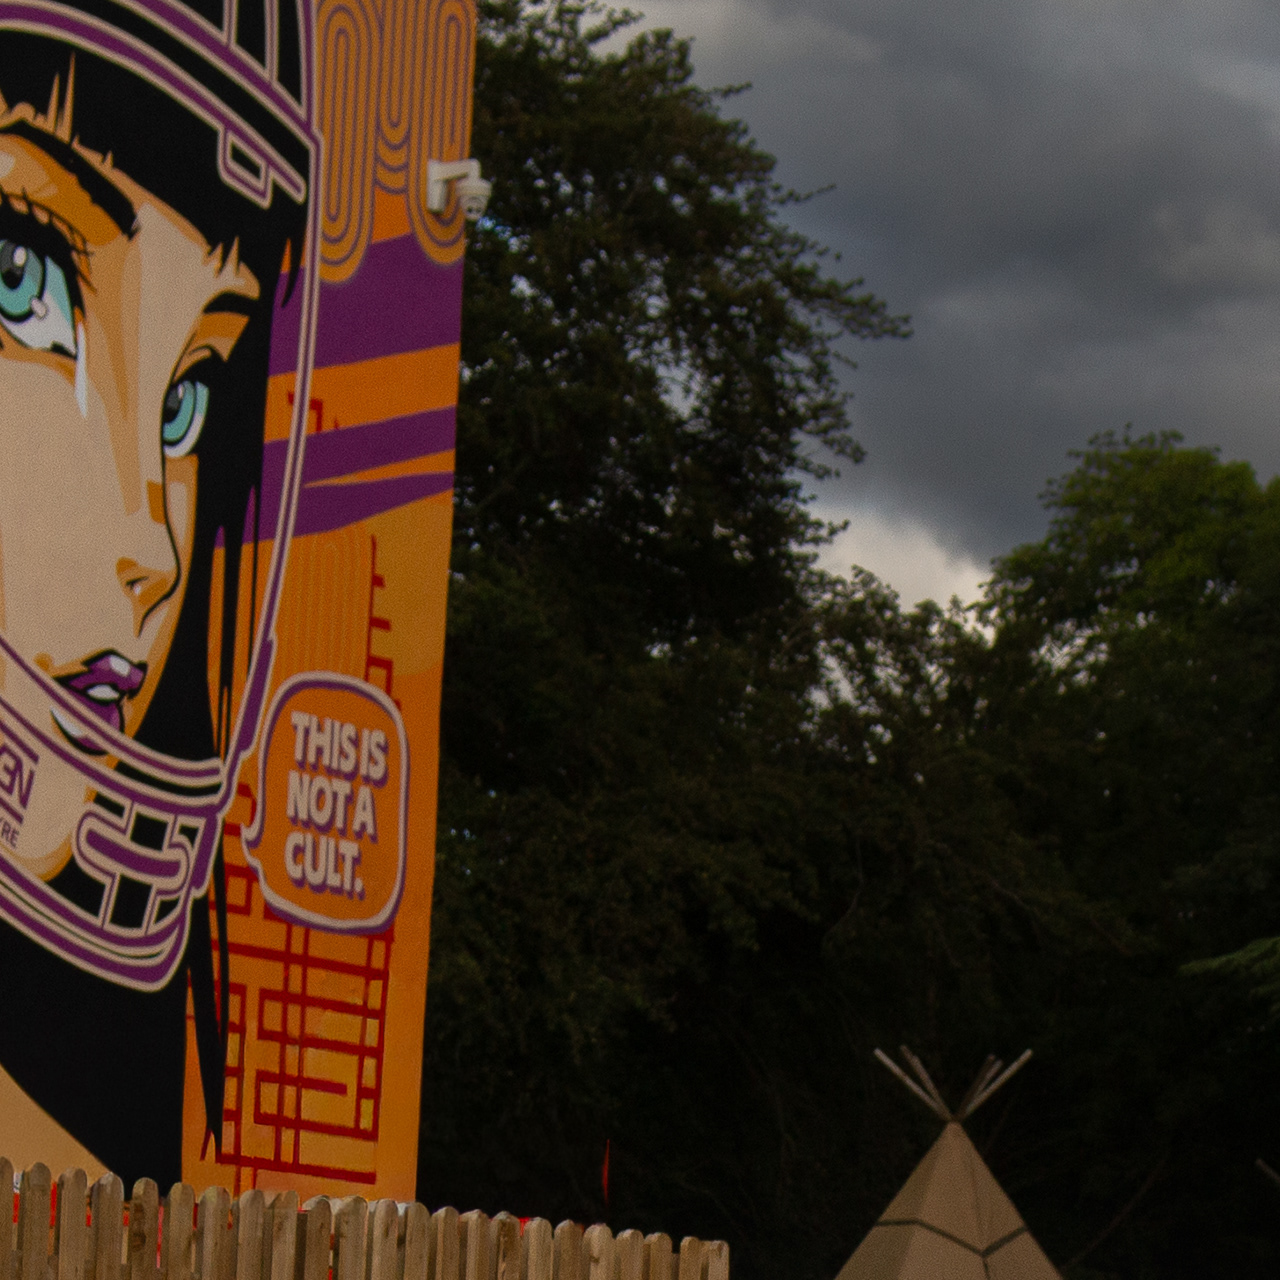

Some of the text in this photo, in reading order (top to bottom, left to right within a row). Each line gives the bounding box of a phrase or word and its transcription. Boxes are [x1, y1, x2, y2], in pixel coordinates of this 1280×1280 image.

[290, 710, 389, 789] THIS IS
[286, 769, 379, 844] NOT A
[284, 830, 365, 900] CULT.
